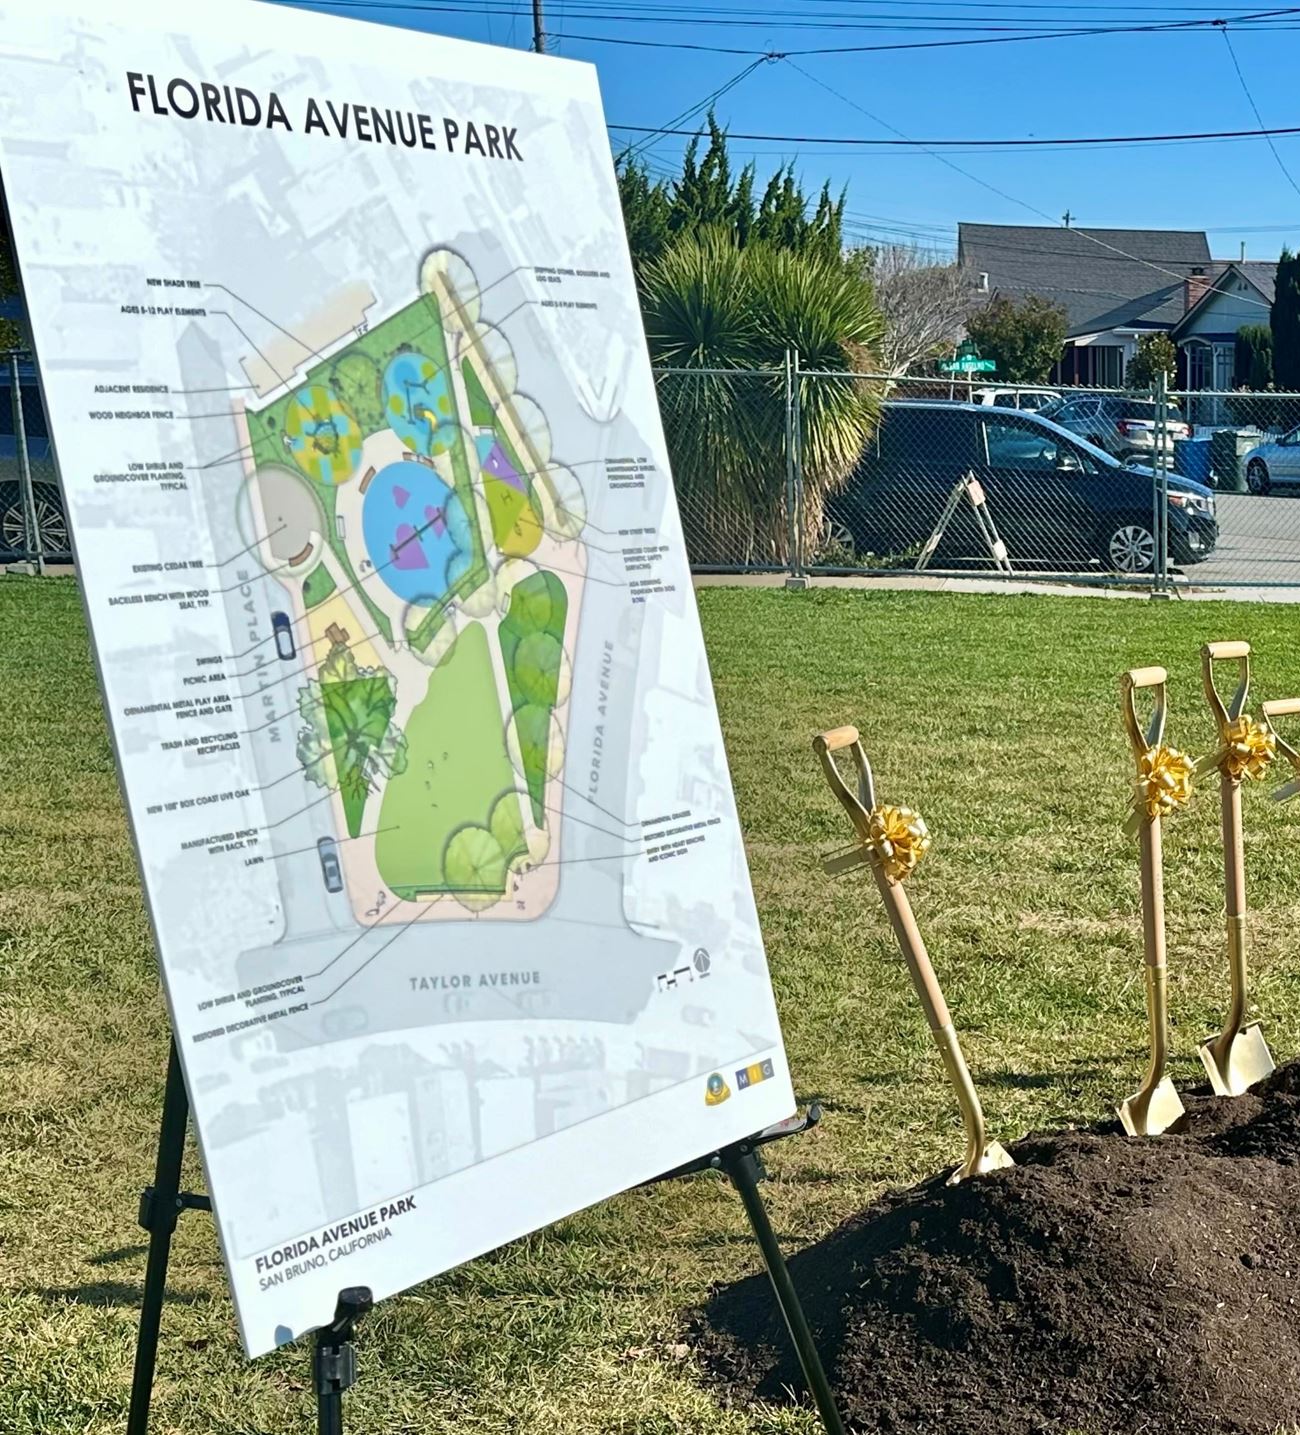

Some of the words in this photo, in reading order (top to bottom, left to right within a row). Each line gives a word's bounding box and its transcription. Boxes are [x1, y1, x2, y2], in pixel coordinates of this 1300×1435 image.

[127, 71, 293, 131] FLORIDA
[304, 97, 436, 150] AVENUE
[443, 117, 524, 161] PARK
[146, 278, 162, 287] NEW
[163, 279, 185, 288] SHADE
[186, 280, 201, 289] TREE
[121, 305, 140, 314] AGES
[157, 306, 173, 315] PLAY
[175, 307, 207, 317] ELEMENTS
[94, 385, 131, 394] ADJACENT
[132, 385, 169, 394] RESIDENCE
[89, 411, 113, 420] WOOD
[114, 411, 151, 419] NEIGHBOR
[152, 411, 174, 419] FENCE
[128, 462, 144, 471] LOW
[145, 462, 167, 470] SHRUB
[168, 461, 184, 470] AND
[93, 472, 149, 483] GROUNDCOVER
[132, 563, 163, 573] EXISTING
[164, 562, 188, 571] CEDAR
[188, 560, 203, 568] TREE
[144, 593, 168, 602] BENCH
[168, 592, 185, 600] WITH
[185, 590, 209, 598] WOOD
[236, 569, 261, 643] PLACE
[183, 675, 207, 685] PICNIC
[208, 673, 226, 682] AREA
[123, 703, 172, 716] ORNAMENTAL
[172, 700, 194, 710] METAL
[194, 697, 211, 706] PLAY
[213, 694, 231, 703] AREA
[254, 654, 282, 743] MARTIN
[175, 709, 198, 719] FENCE
[199, 706, 214, 716] AND
[215, 704, 233, 713] GATE
[586, 724, 605, 805] FLORIDA
[597, 640, 615, 717] AVENUE
[161, 741, 183, 751] TRASH
[184, 737, 199, 747] AND
[200, 731, 238, 744] RECYCLING
[197, 741, 240, 755] RECEPTACLES
[146, 805, 163, 814] NEW
[180, 798, 195, 809] BOX
[196, 794, 219, 806] COAST
[220, 792, 234, 801] LIVE
[234, 789, 250, 798] OAK
[181, 832, 235, 850] MANUFACTURED
[235, 828, 258, 839] BENCH
[208, 845, 225, 855] WITH
[244, 856, 264, 867] LAWN
[409, 974, 472, 992] TAYLOR
[478, 970, 542, 988] AVENUE
[197, 1000, 214, 1011] LOW
[214, 994, 236, 1006] SHRUB
[237, 989, 252, 1000] AND
[252, 975, 303, 996] GROUNDCOVER
[279, 985, 305, 998] TYPICAL
[192, 1027, 226, 1043] RESTORED
[226, 1014, 267, 1034] DECORATIVE
[267, 1009, 288, 1022] METAL
[288, 1002, 309, 1015] FENCE
[737, 1061, 773, 1089] MIG
[255, 1236, 320, 1274] FLORIDA
[321, 1210, 379, 1247] AVENUE
[380, 1195, 418, 1223] PARK
[259, 1271, 284, 1292] SAN
[284, 1253, 329, 1281] BRUNO,
[328, 1226, 393, 1262] CALIFORNIA
